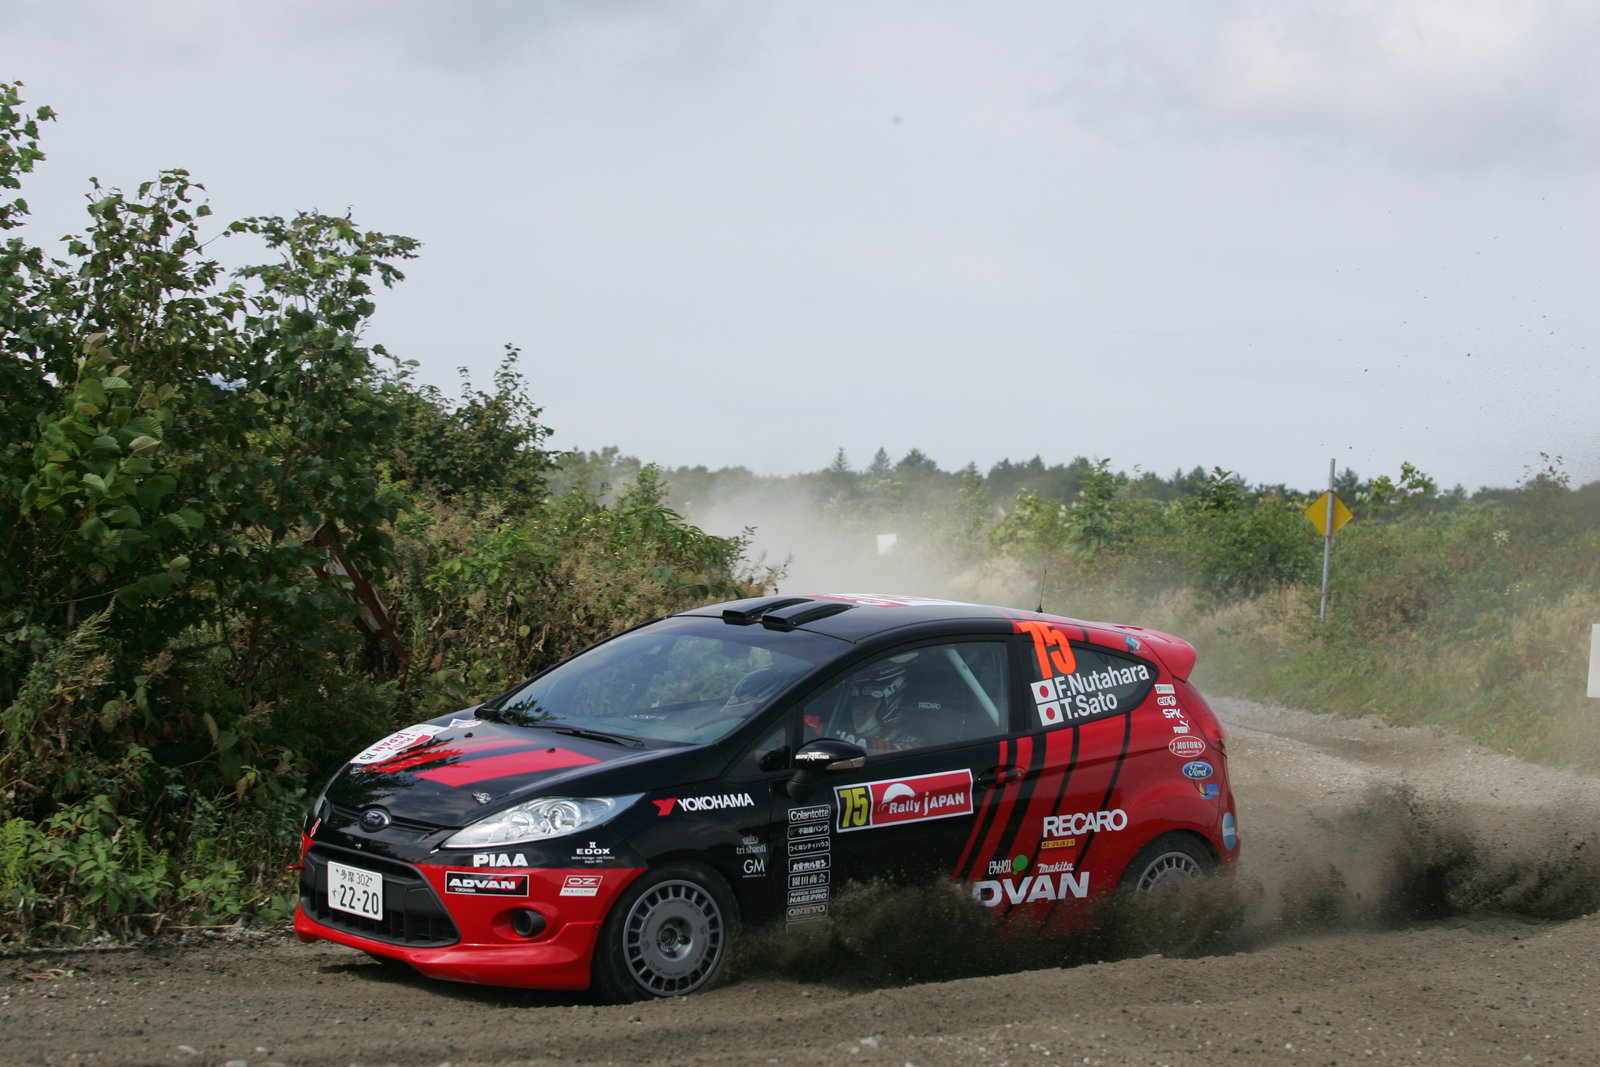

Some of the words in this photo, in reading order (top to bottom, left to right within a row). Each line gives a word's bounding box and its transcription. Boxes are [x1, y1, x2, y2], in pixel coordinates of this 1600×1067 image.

[1016, 621, 1077, 679] 75
[1054, 664, 1150, 698] F.Nutahara
[1060, 692, 1118, 719] T.Sato
[1162, 708, 1184, 718] SPK
[1189, 764, 1208, 777] Ford
[677, 793, 754, 811] YOKOHAMA
[840, 787, 869, 828] 75
[888, 800, 921, 814] Rally
[1043, 808, 1128, 838] RECARO
[473, 853, 528, 867] PIAA
[743, 859, 765, 874] GM
[356, 872, 369, 887] 302
[448, 878, 516, 890] ADVAN
[340, 884, 379, 915] 22-20
[788, 905, 826, 916] ONKYO
